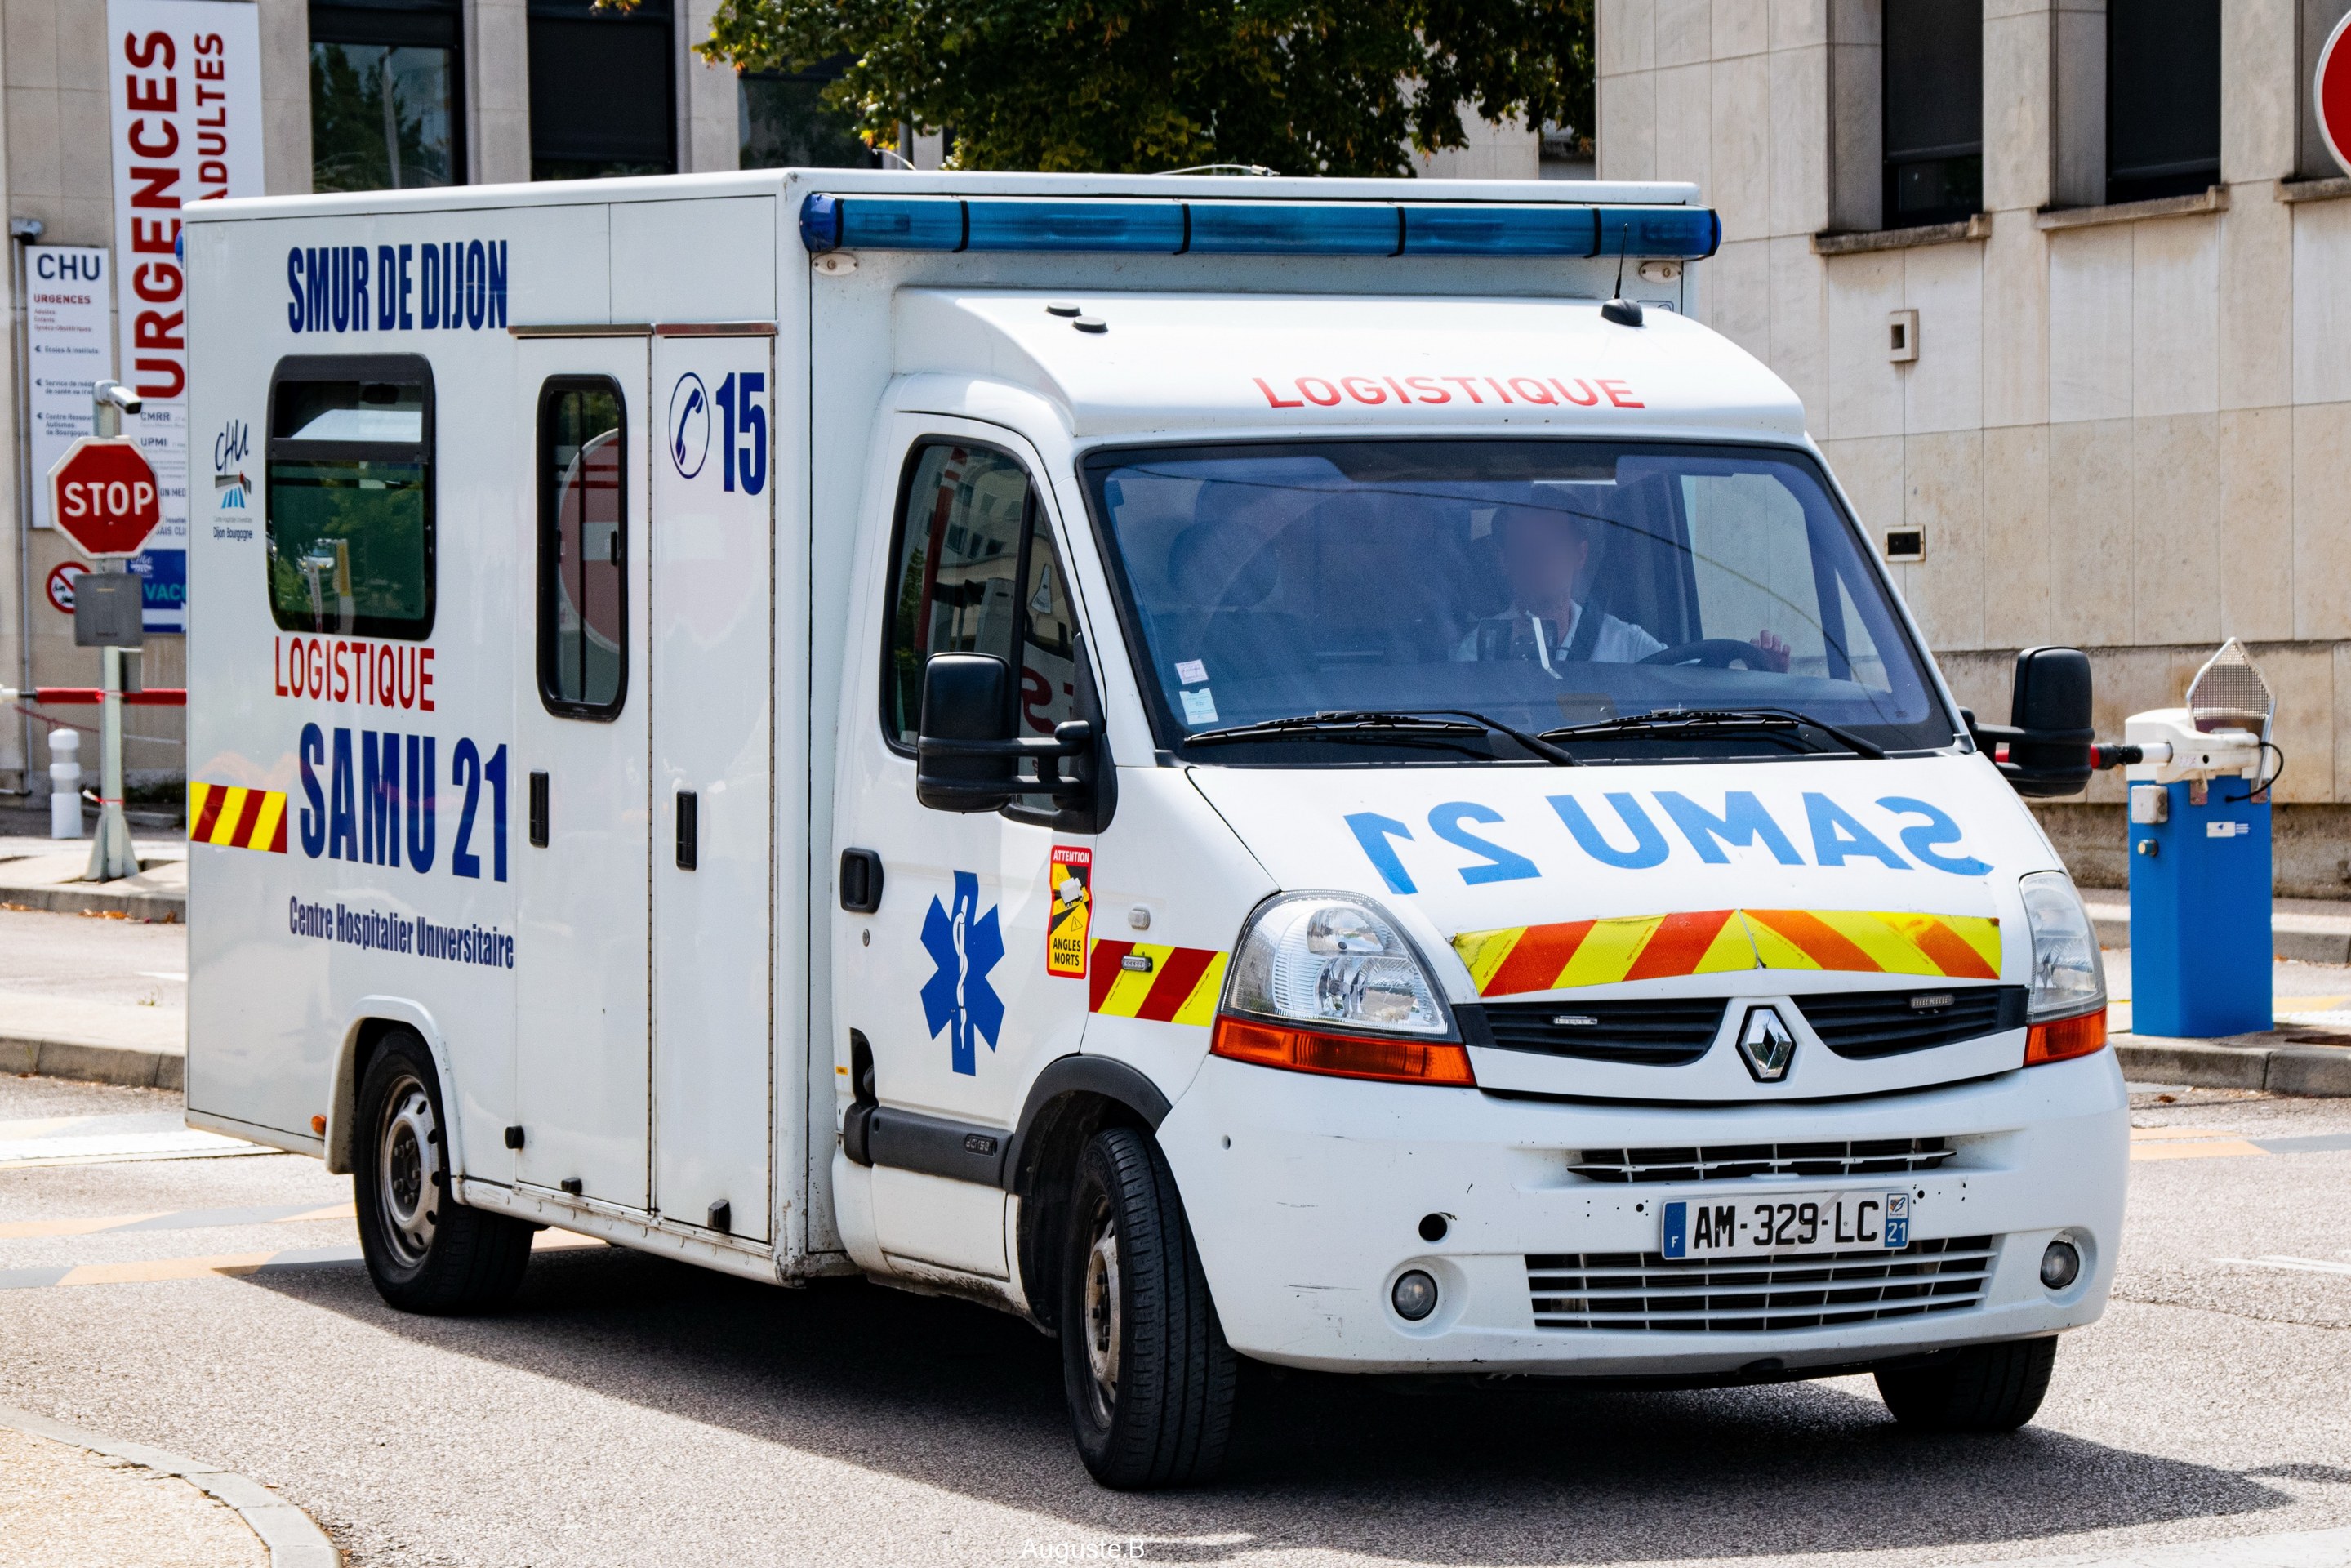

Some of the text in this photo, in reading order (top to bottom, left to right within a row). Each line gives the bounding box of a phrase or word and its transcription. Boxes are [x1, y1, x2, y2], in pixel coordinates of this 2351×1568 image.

[124, 30, 185, 399] URGENCES
[37, 253, 100, 281] CHU
[287, 238, 507, 333] SMUR DE DIJON
[33, 293, 91, 305] URGENCES
[1252, 376, 1646, 408] LOGISTIQUE
[68, 412, 93, 421] Ressour
[140, 412, 170, 421] CMRR
[55, 429, 89, 437] Bourgogne
[140, 438, 167, 447] UPMI
[715, 372, 766, 496] 15
[214, 418, 249, 476] CHU
[64, 481, 154, 516] STOP
[227, 527, 252, 541] Bourgogne
[275, 636, 434, 711] LOGISTIQUE
[300, 722, 507, 882] SAMU 21
[1053, 849, 1089, 863] ATTENTION
[289, 895, 514, 969] Centre Hospitalier Universitaire
[1053, 938, 1081, 951] ANGLES
[1054, 952, 1080, 966] MORTS
[1694, 1200, 1879, 1249] AM-329-LC
[1887, 1222, 1907, 1242] 21
[1672, 1236, 1678, 1248] F
